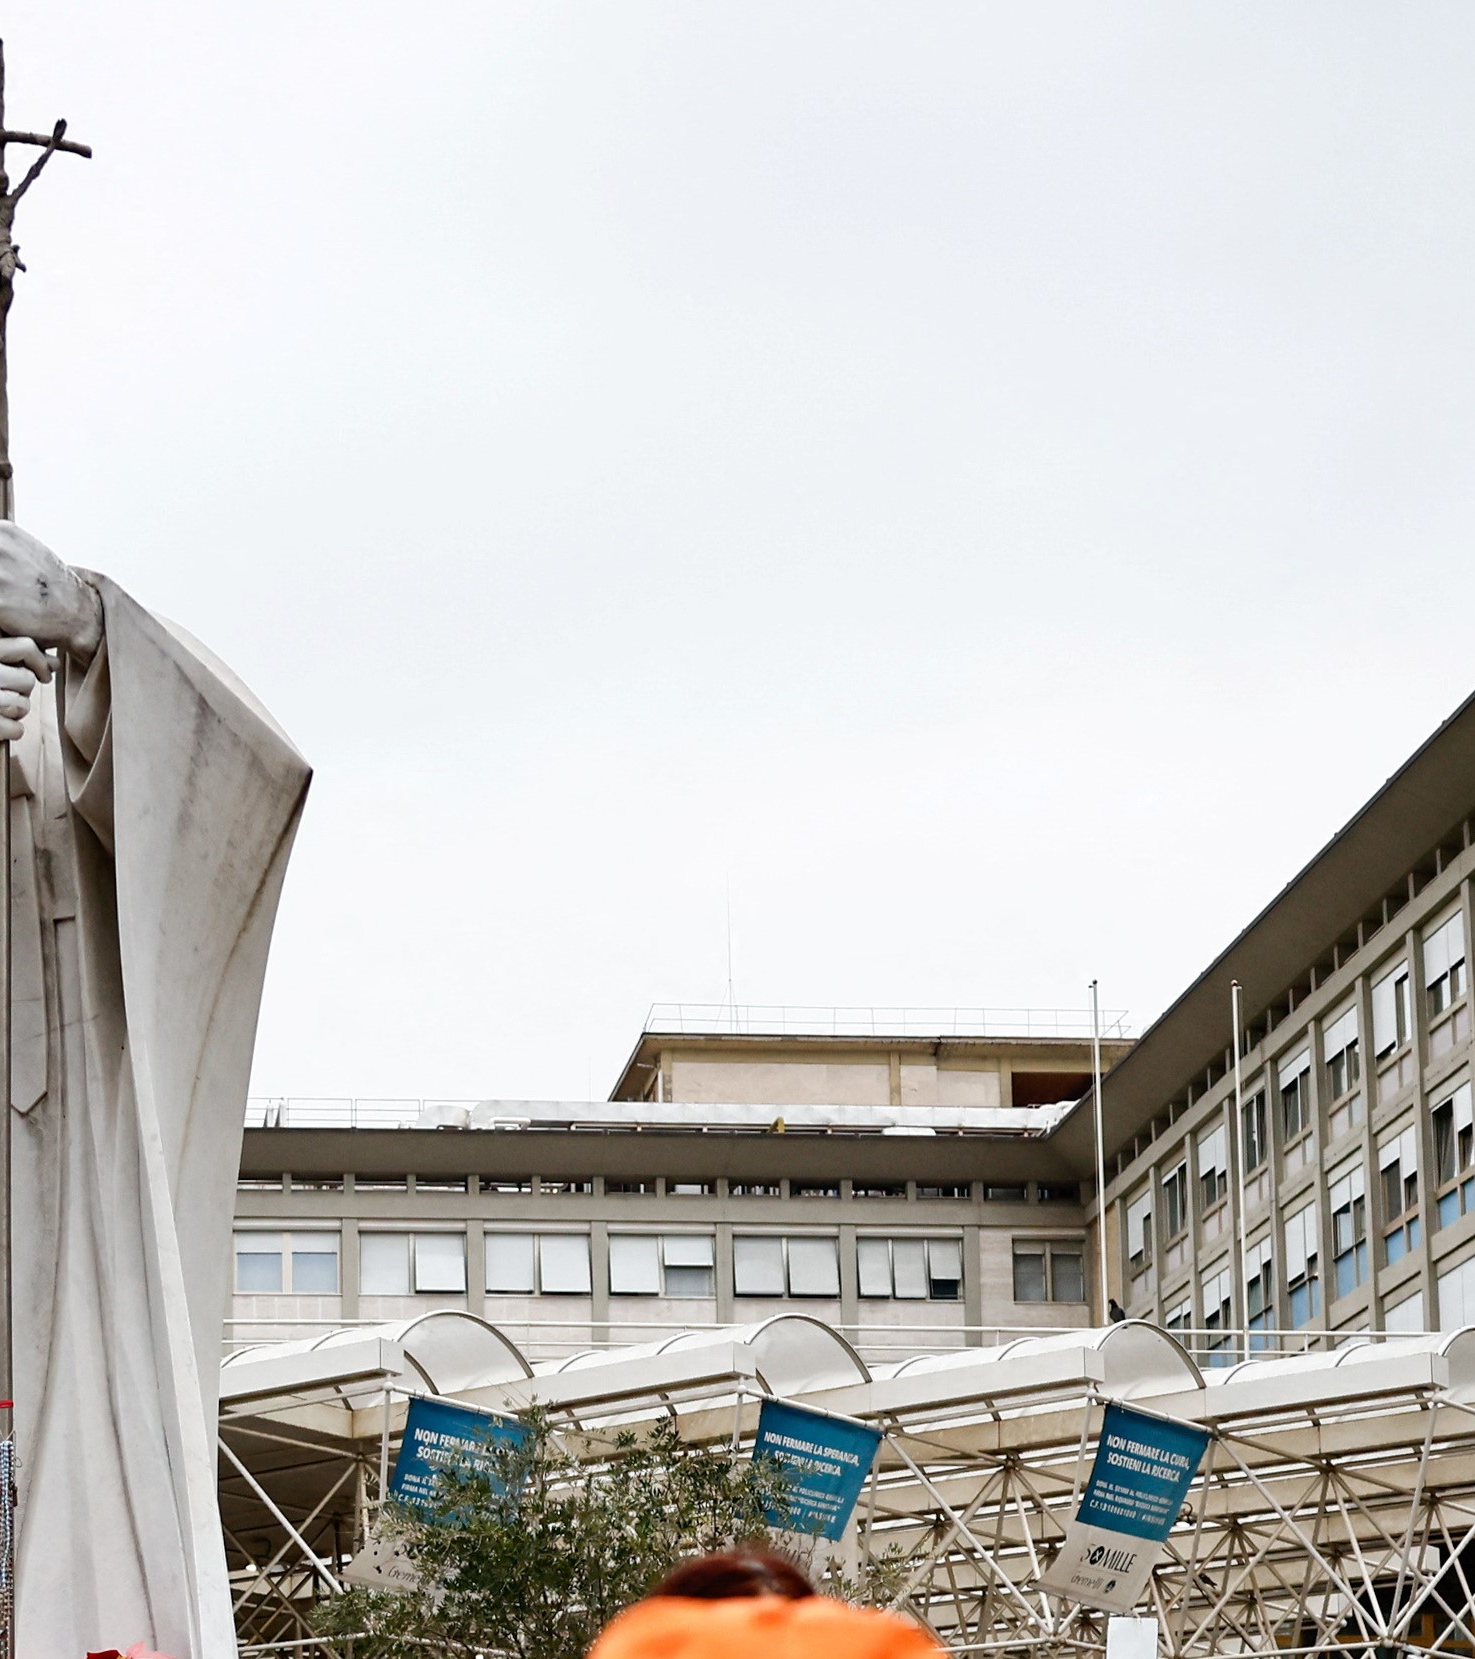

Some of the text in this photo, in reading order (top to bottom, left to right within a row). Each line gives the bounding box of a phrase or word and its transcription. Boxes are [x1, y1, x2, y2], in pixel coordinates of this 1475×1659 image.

[414, 1427, 438, 1445] NON
[764, 1432, 859, 1466] NON FERMARE LA SPERANZA,
[1107, 1435, 1190, 1470] NON FERMARE LA CURA,
[1107, 1452, 1142, 1473] SOSTIENI
[1141, 1461, 1152, 1475] LA
